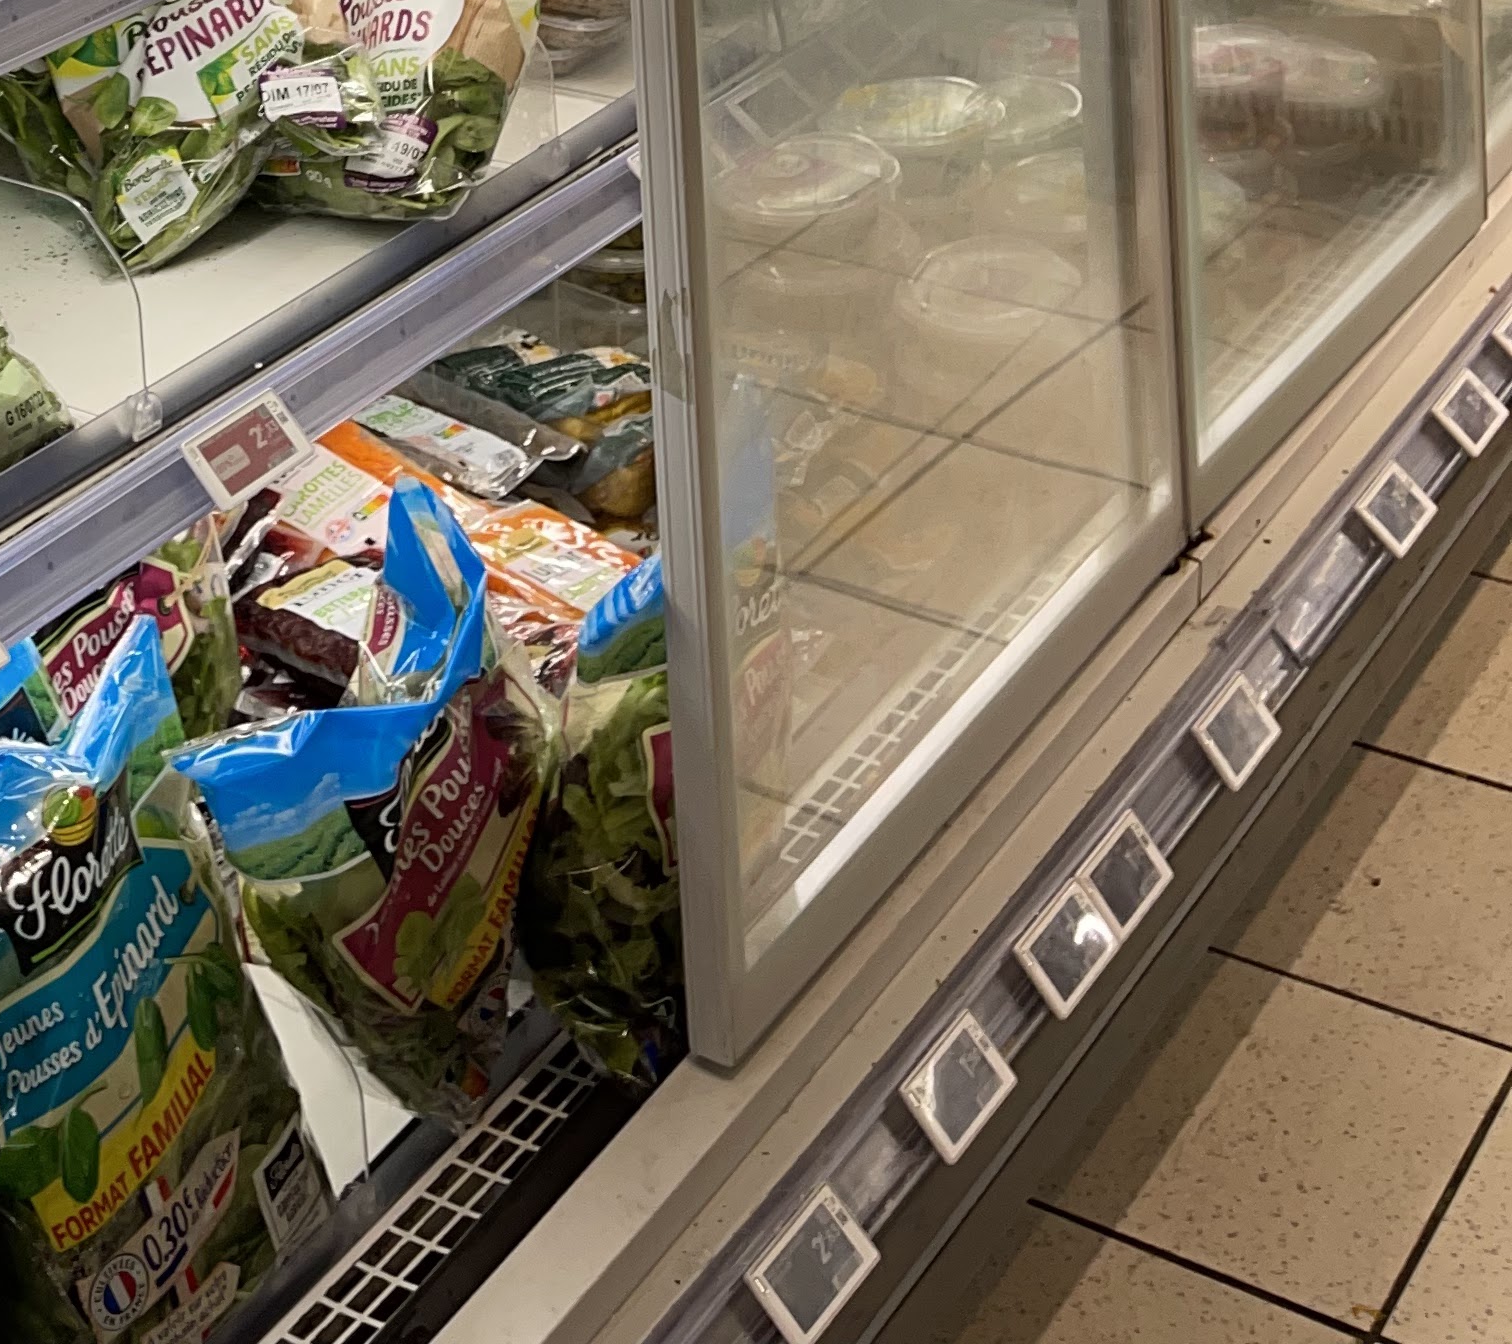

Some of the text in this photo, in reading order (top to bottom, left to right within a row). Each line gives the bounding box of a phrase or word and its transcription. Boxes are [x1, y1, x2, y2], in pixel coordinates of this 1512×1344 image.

[240, 15, 294, 64] SANS
[376, 55, 421, 76] ANS
[261, 87, 289, 103] DIM
[295, 81, 329, 98] 17/07
[4, 408, 16, 427] G
[418, 780, 486, 874] Douces
[7, 808, 134, 943] Florette
[4, 1035, 84, 1101] Pousses
[50, 1172, 131, 1251] FORMAT
[126, 1048, 216, 1181] FAMILIAL
